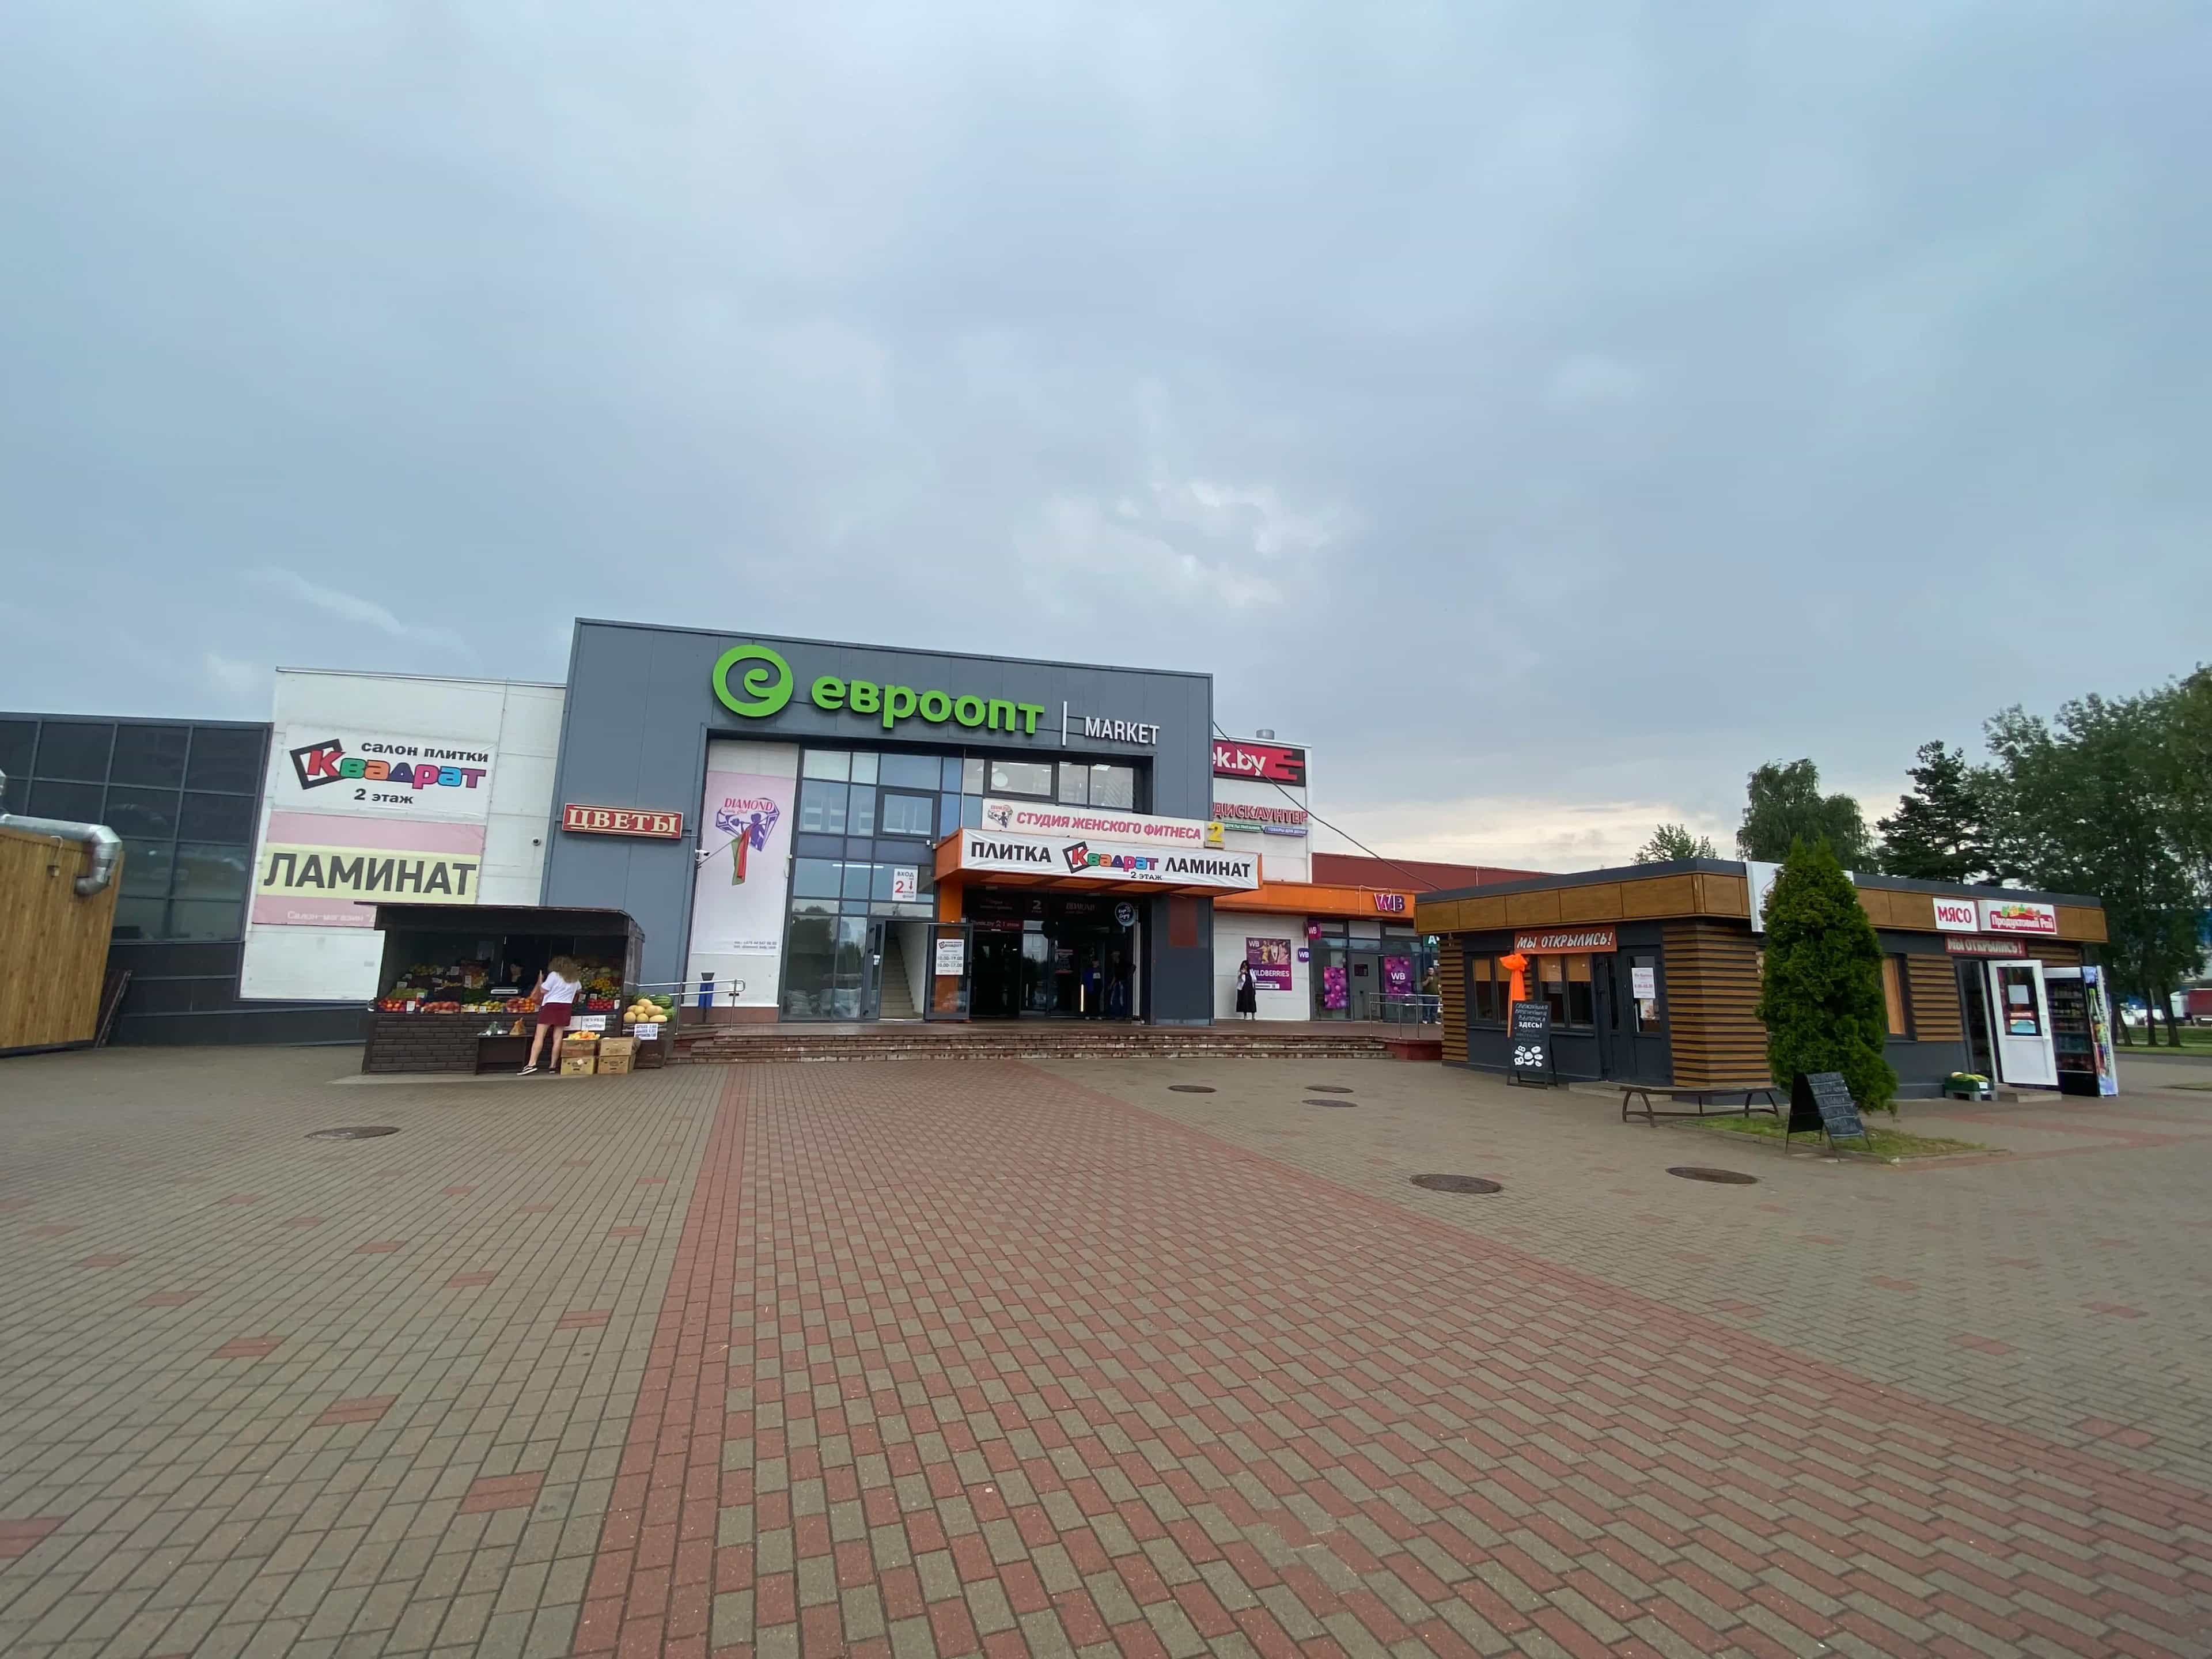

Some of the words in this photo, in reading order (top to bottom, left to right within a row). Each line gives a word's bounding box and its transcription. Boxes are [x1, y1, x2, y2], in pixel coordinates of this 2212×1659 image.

[811, 675, 1046, 735] евроопт
[1085, 715, 1161, 745] MARKET
[361, 741, 418, 757] салон
[424, 748, 489, 763] плитки
[306, 749, 486, 790] Квадрат
[354, 788, 366, 801] 2
[372, 791, 414, 805] этаж
[724, 798, 772, 811] DIAMOND
[567, 809, 678, 833] ЦВЕТЫ
[1213, 802, 1308, 823] ДИСКАУНТЕР
[1016, 811, 1070, 828] СТУДИЯ
[1071, 815, 1142, 834] ЖЕНСКОГО
[1145, 823, 1202, 840] ФИТНЕСА
[1208, 822, 1225, 843] 2
[971, 841, 1052, 863] ПЛИТКА
[1071, 847, 1159, 872] Квадрат
[1165, 857, 1251, 878] ЛАМИНАТ
[263, 852, 477, 896] ЛАМИНАТ
[895, 880, 904, 893] 2
[1374, 893, 1405, 912] WB
[1937, 906, 1972, 923] МЯСО
[1517, 937, 1537, 949] МЫ
[1541, 932, 1613, 948] ОТКРЫЛИСЬ!
[1948, 938, 1964, 950] МЫ
